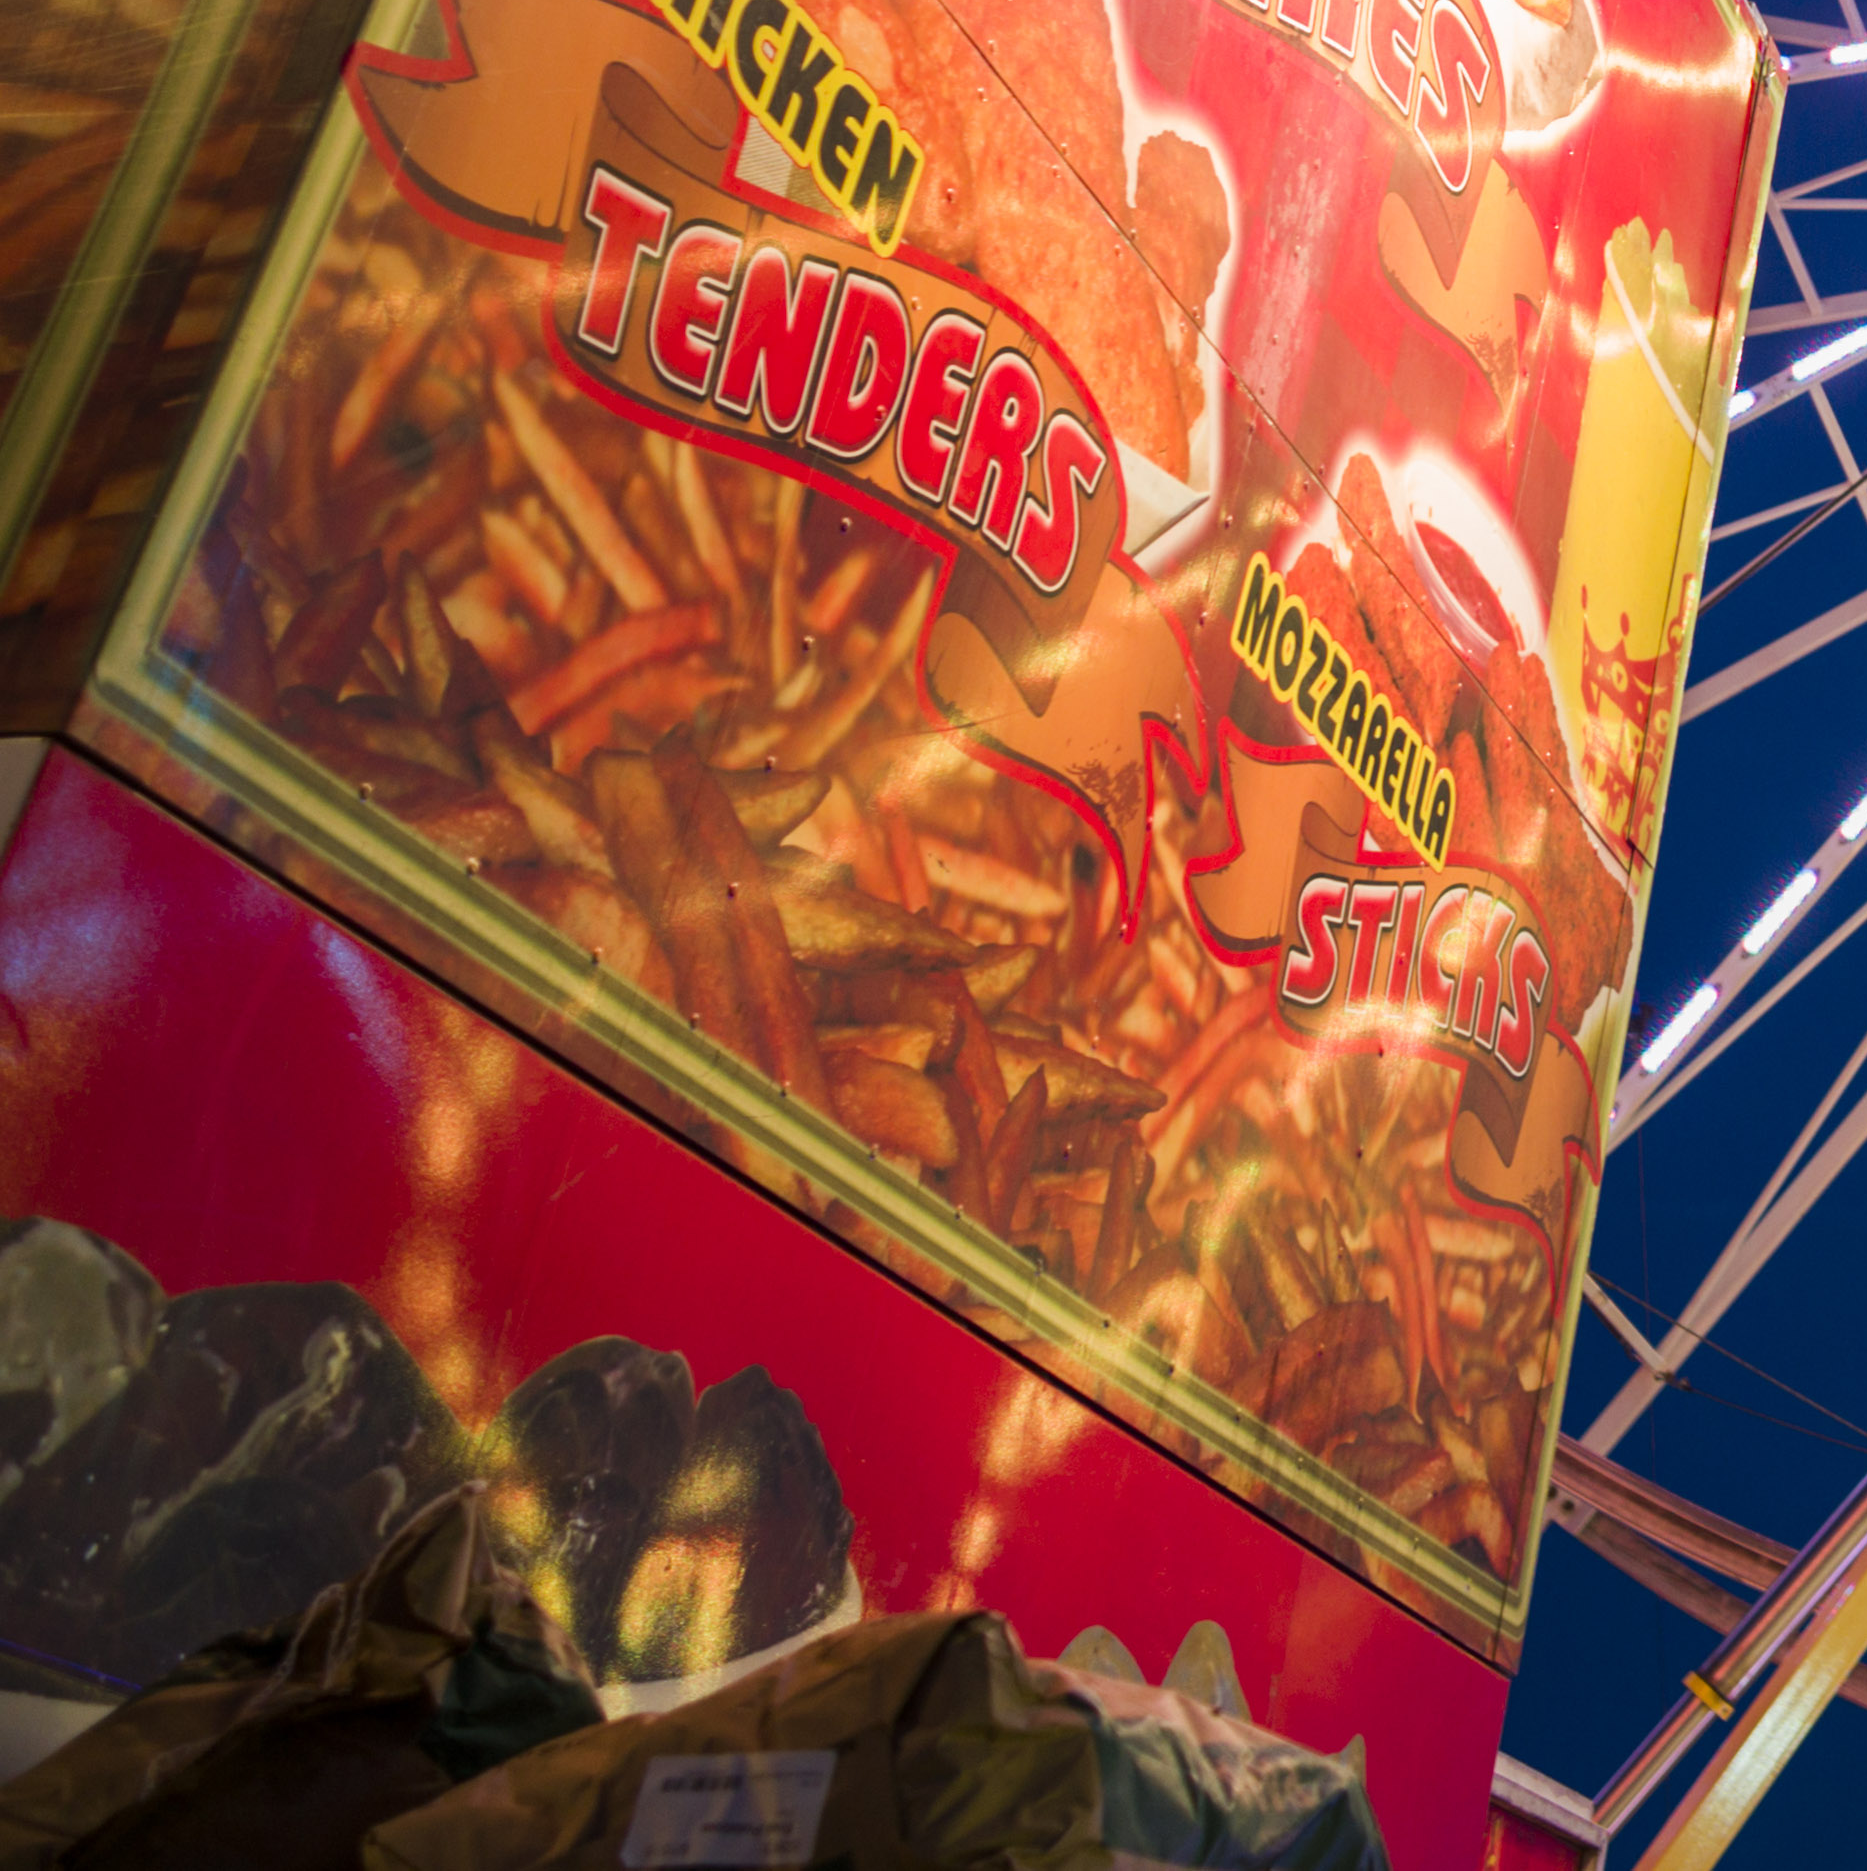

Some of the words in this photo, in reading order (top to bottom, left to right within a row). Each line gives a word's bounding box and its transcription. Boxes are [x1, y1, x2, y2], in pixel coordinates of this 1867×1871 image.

[576, 167, 1106, 594] TENDERS
[1236, 558, 1453, 867] MOZZARELLA
[1283, 876, 1550, 1077] STICKS
